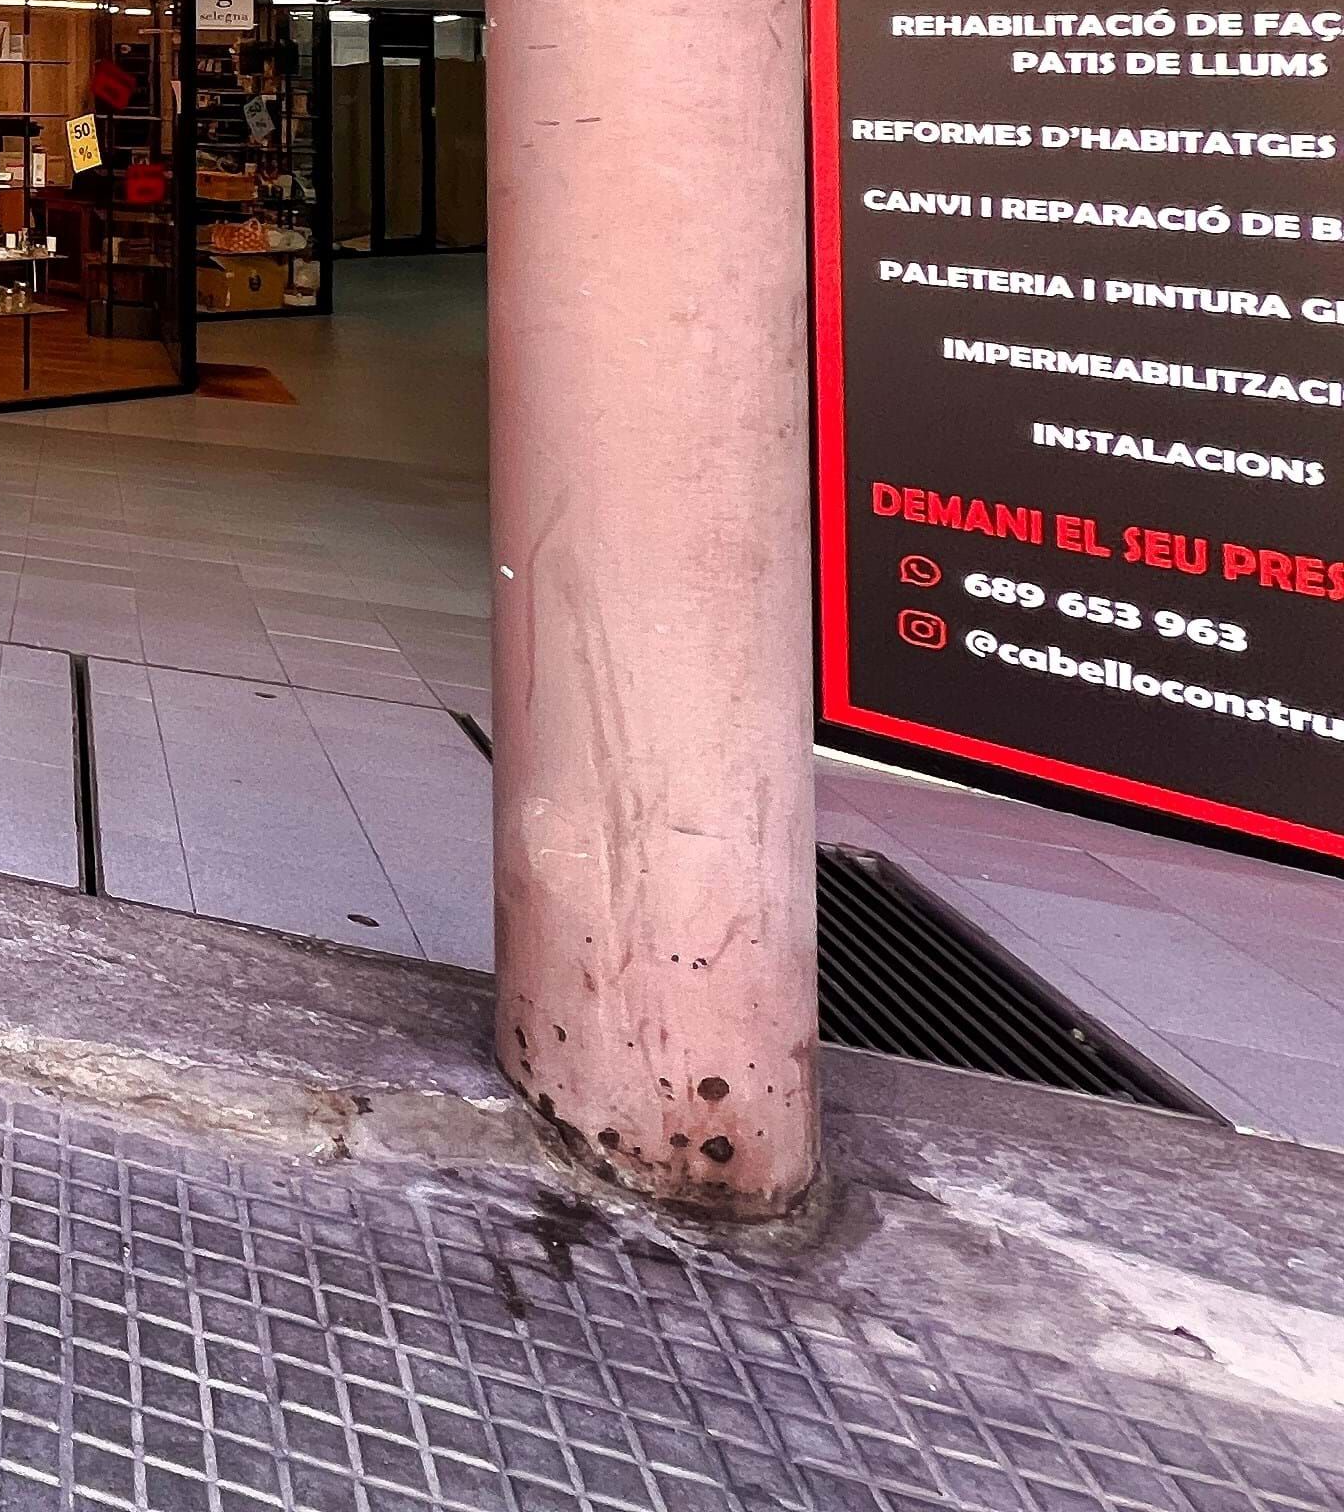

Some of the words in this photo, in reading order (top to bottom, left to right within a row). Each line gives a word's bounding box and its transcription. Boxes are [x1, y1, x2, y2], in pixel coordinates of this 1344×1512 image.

[890, 8, 1178, 39] REHABILITACIÓ
[1184, 13, 1243, 37] DE
[1012, 51, 1116, 75] PATIS
[1126, 52, 1181, 77] DE
[1190, 51, 1330, 78] LLUMS
[73, 122, 91, 140] 50
[78, 145, 93, 162] %
[851, 118, 1032, 148] REFORMES
[1041, 125, 1338, 160] D'HABITATGES
[862, 188, 972, 218] CANVI
[980, 196, 992, 218] I
[1001, 196, 1232, 234] REPARACIÓ
[1239, 211, 1301, 240] DE
[879, 260, 1075, 300] PALETERIA
[1083, 278, 1095, 301] I
[1104, 279, 1292, 320] PINTURA
[1032, 422, 1327, 487] INSTALACIONS
[872, 482, 1045, 546] DEMANI
[1055, 514, 1112, 559] EL
[1123, 526, 1209, 575] SEU
[963, 573, 1046, 609] 689
[1056, 591, 1142, 630] 653
[1153, 609, 1249, 653] 963
